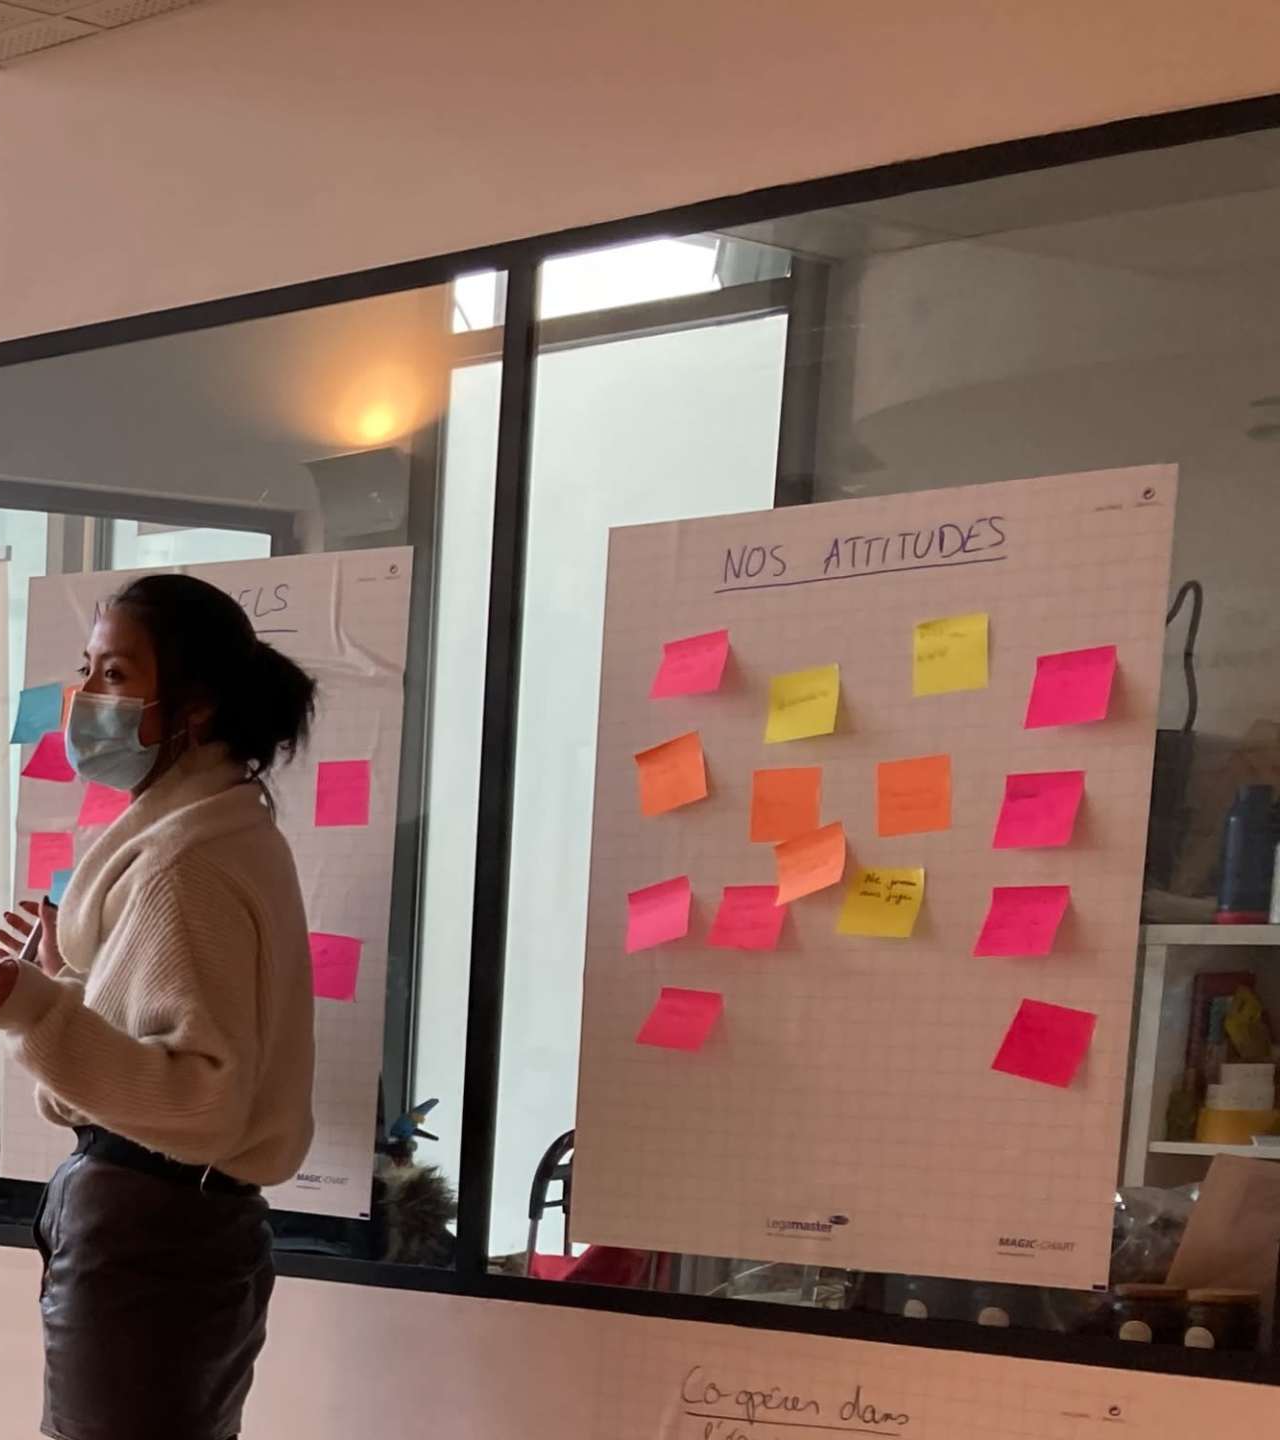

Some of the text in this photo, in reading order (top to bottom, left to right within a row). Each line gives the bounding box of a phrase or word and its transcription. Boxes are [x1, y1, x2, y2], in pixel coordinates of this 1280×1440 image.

[722, 516, 1006, 584] NOS ATTITUDES
[840, 1386, 910, 1427] dans
